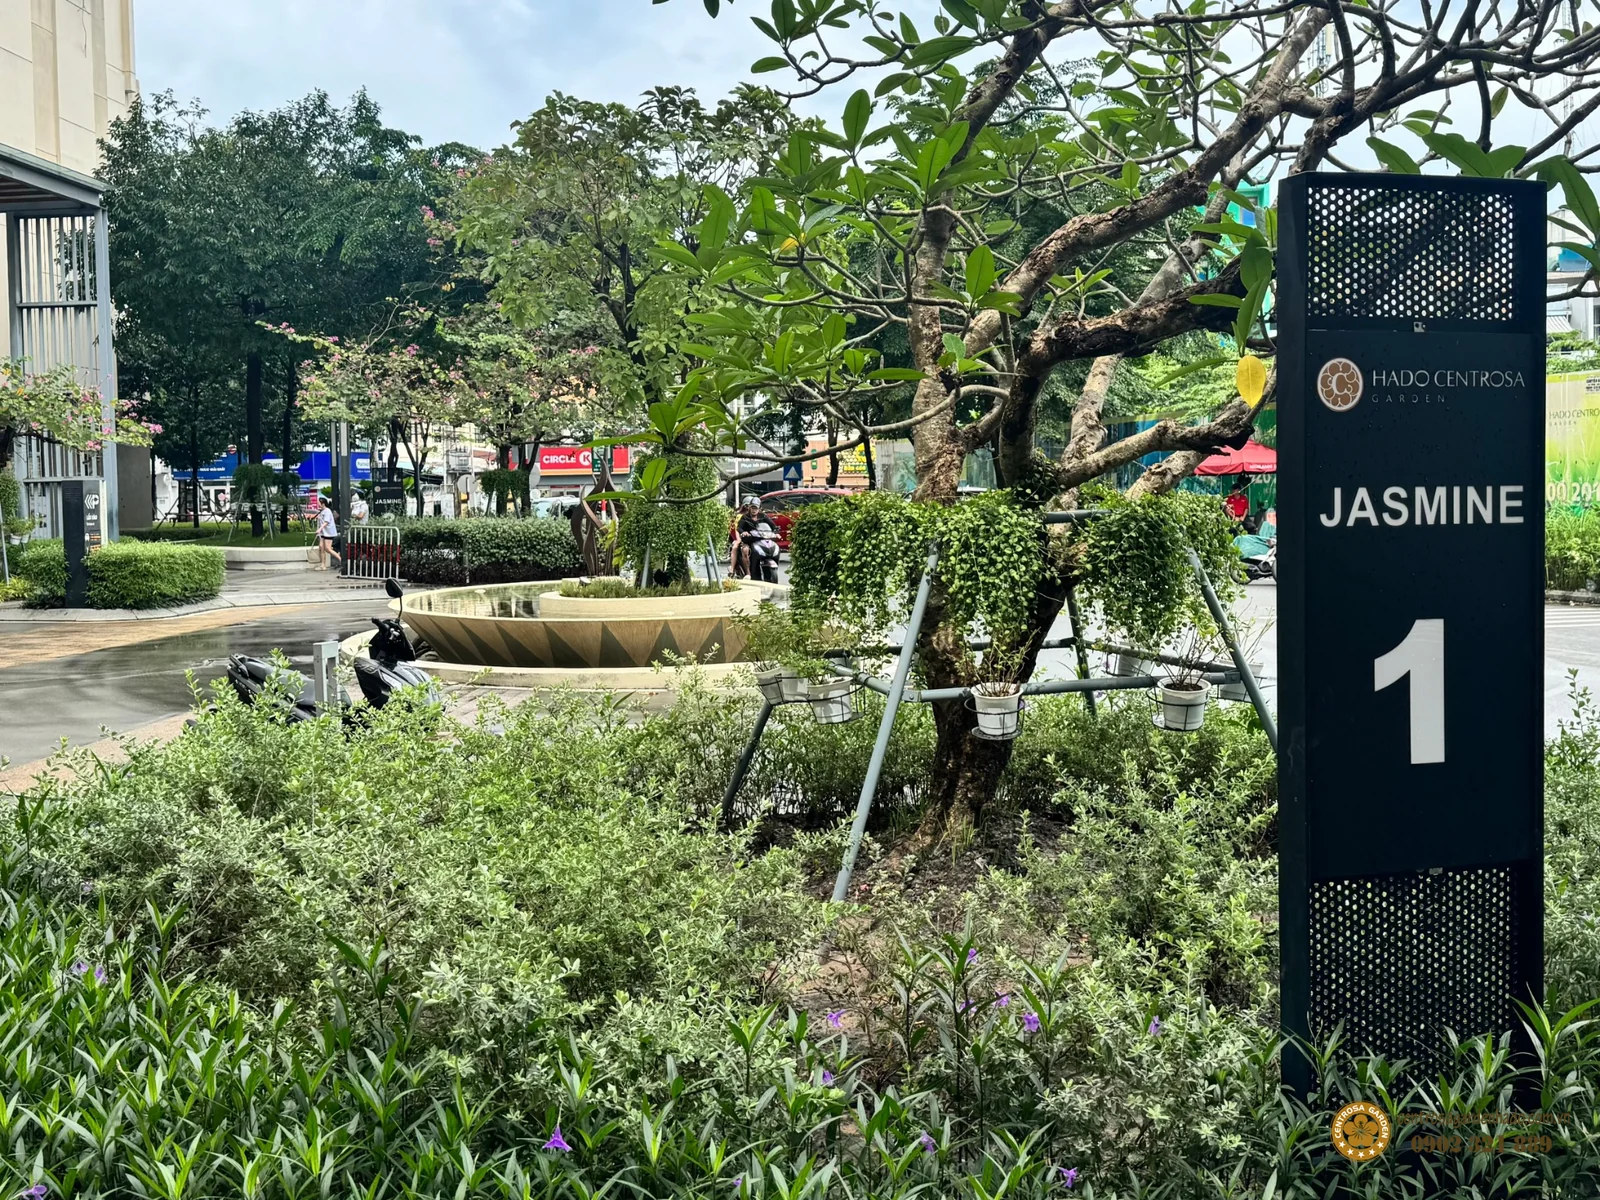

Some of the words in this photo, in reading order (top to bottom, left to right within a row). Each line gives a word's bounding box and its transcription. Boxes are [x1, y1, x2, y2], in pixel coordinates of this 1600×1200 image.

[1372, 369, 1430, 387] HADO
[1434, 370, 1526, 388] CENTROSA
[1371, 393, 1445, 403] GARDEN
[1548, 410, 1571, 420] HADO
[542, 454, 577, 465] CIRCLE
[1319, 485, 1525, 528] JASMINE
[1374, 618, 1445, 765] 1
